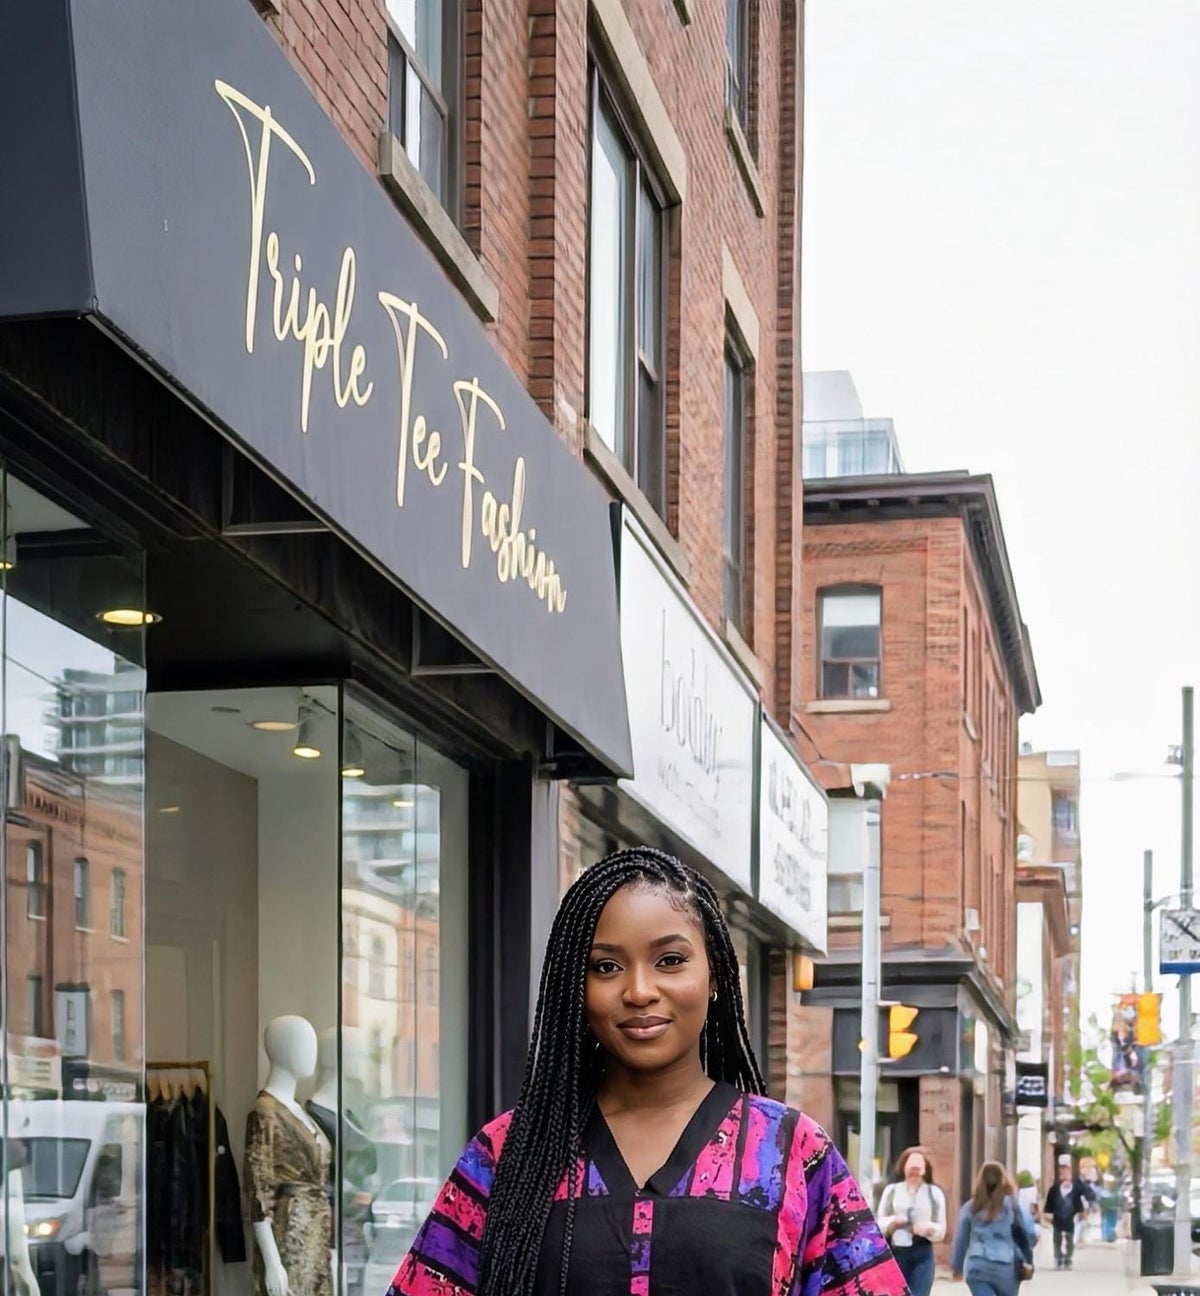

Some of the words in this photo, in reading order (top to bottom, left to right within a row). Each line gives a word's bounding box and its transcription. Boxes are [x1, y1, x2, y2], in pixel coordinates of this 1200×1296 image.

[215, 79, 374, 432] Triple
[378, 290, 448, 506] Tee
[453, 377, 567, 613] Fashion
